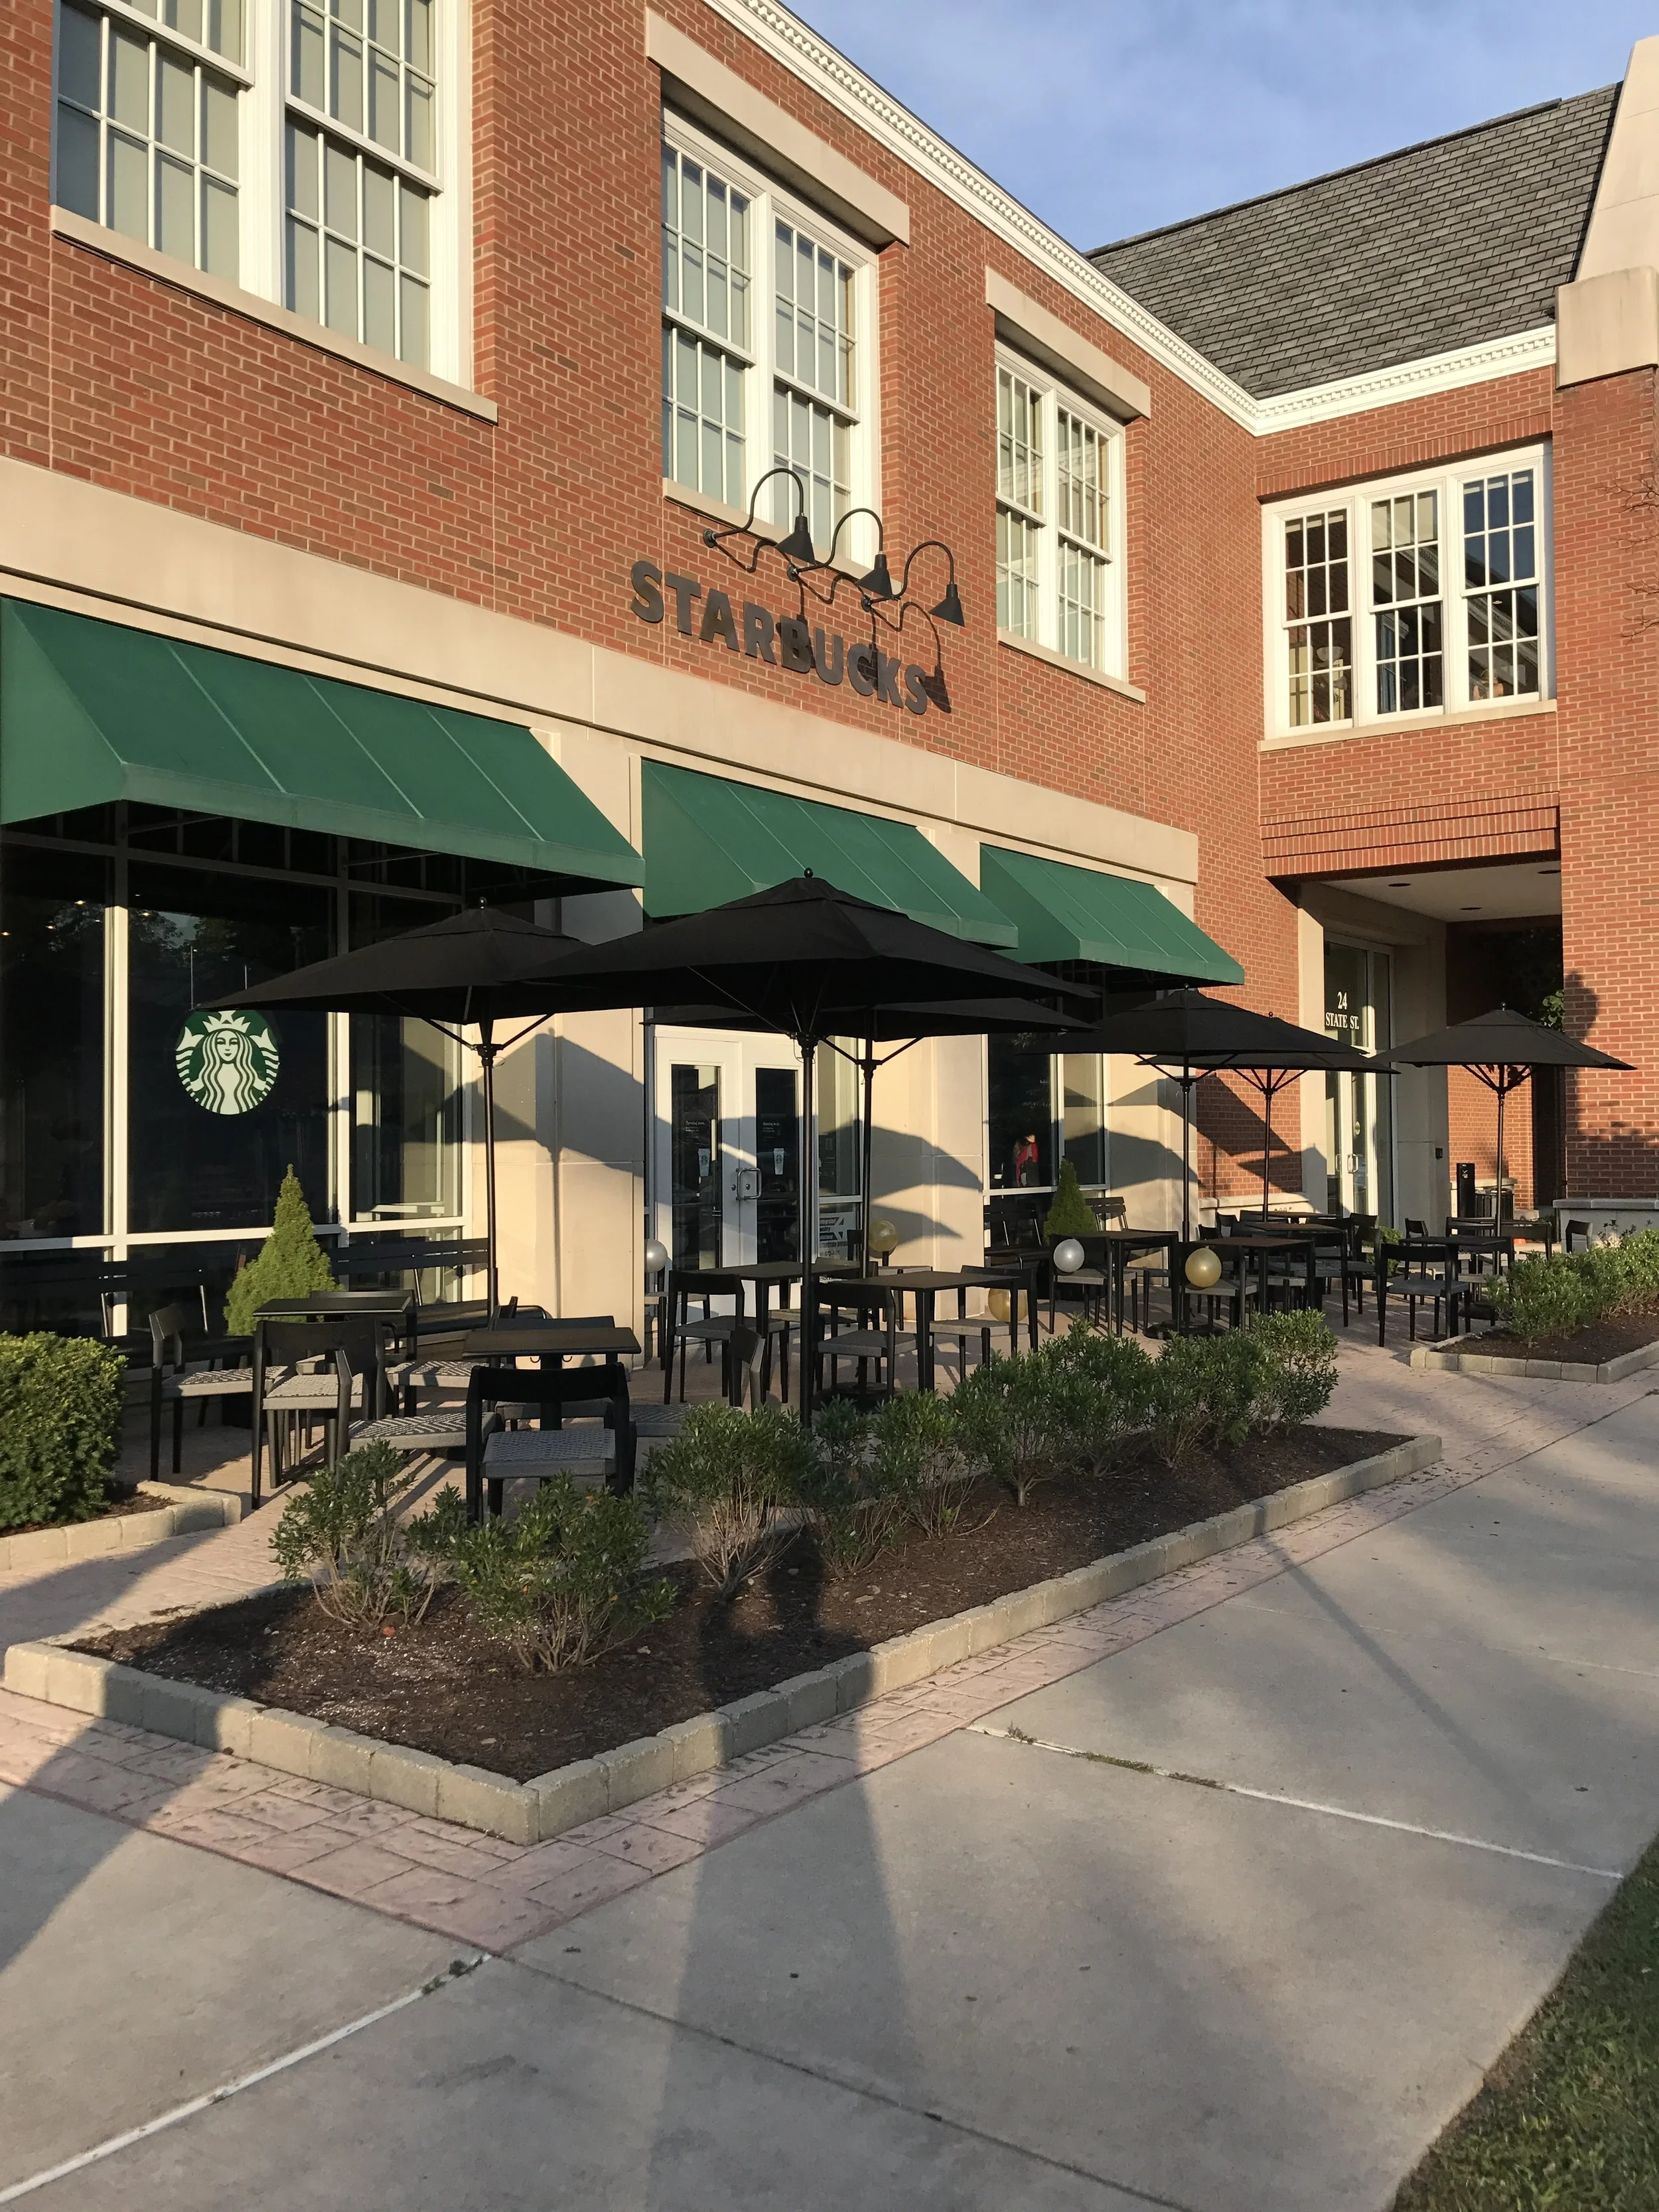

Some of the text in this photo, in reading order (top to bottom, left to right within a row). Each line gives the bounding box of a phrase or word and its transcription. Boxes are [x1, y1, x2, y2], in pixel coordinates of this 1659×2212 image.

[630, 561, 928, 715] STARBUCKS
[1337, 991, 1348, 1010] 24
[1325, 1012, 1360, 1029] STATE ST.
